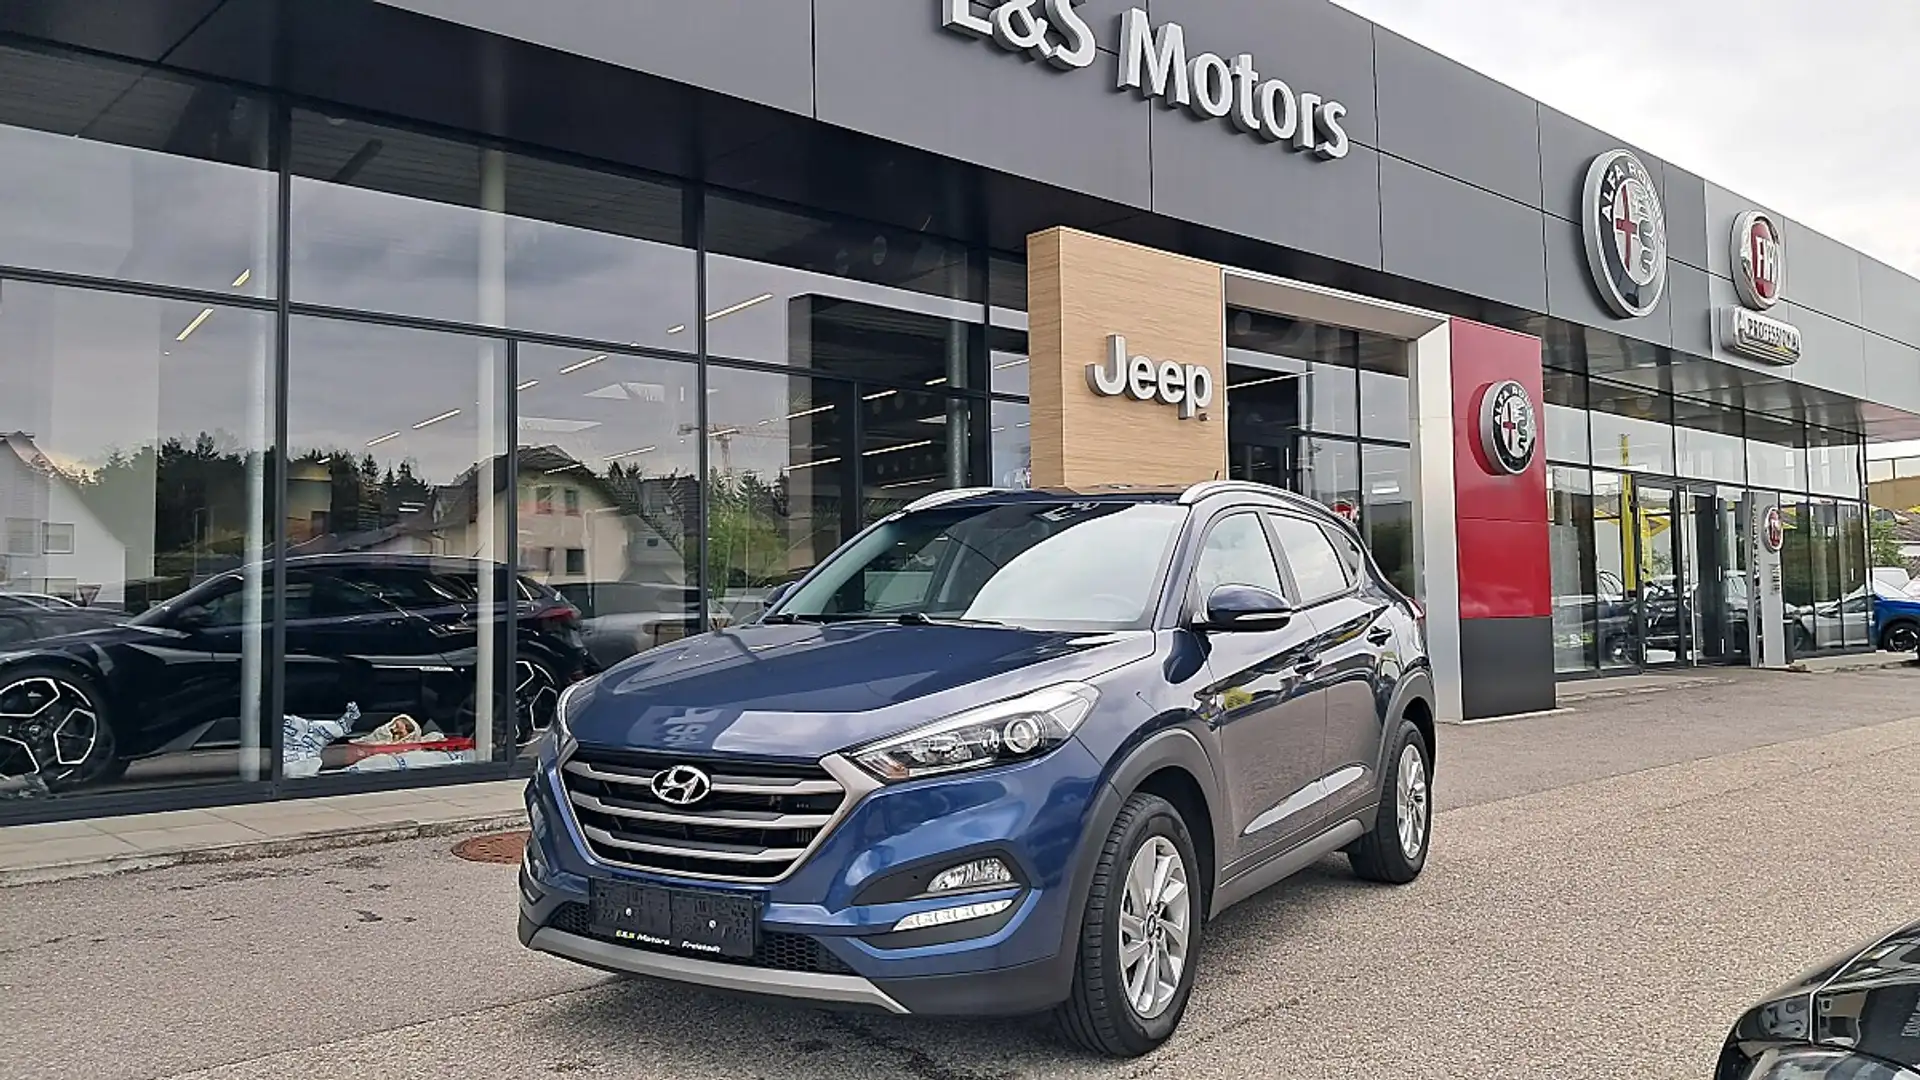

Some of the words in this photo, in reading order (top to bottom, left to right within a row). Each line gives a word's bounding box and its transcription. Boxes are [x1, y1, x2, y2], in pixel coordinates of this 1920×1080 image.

[943, 0, 1096, 70] &S
[1117, 7, 1350, 160] Motors
[1601, 164, 1625, 222] ALFA
[1085, 333, 1213, 420] Jeep
